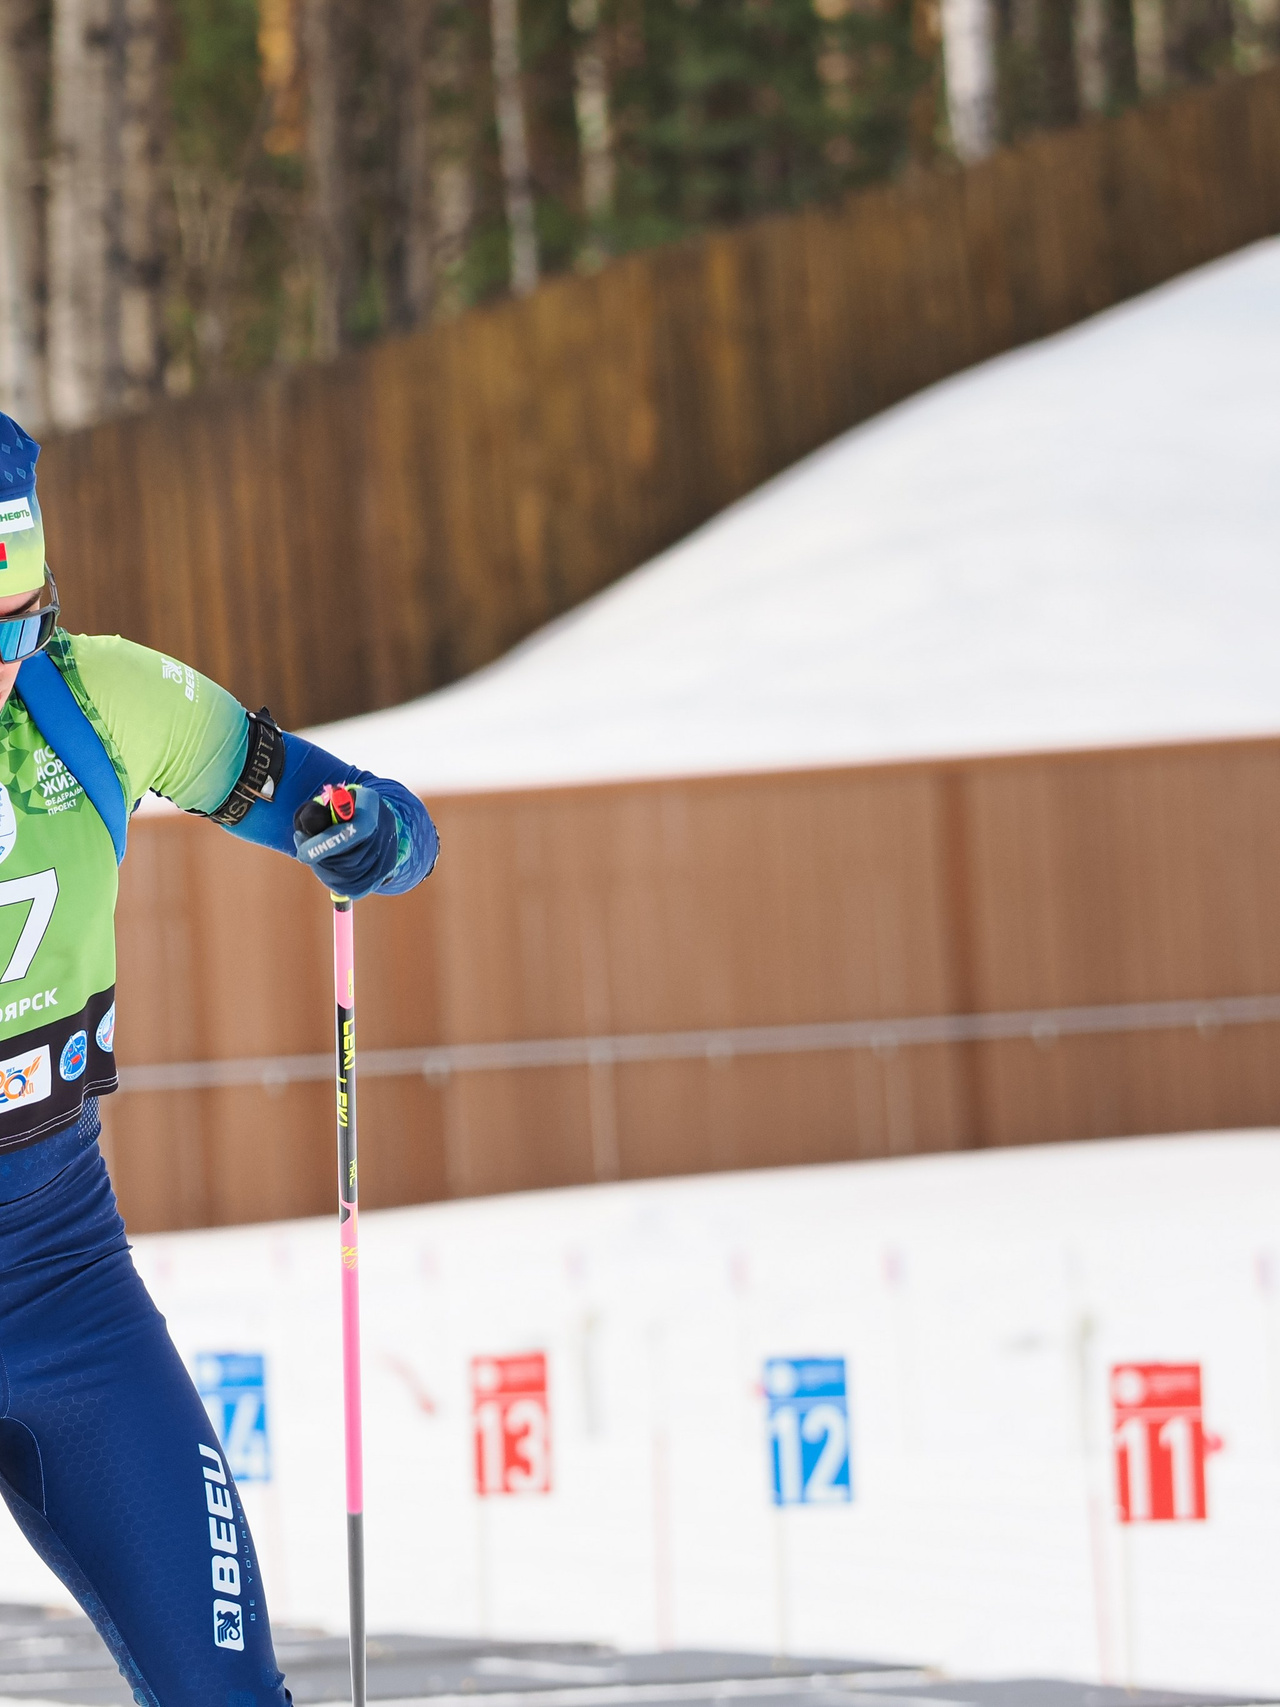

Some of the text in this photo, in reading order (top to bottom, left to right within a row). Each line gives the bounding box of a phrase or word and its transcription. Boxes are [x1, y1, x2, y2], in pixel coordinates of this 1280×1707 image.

[184, 667, 195, 702] BEE
[37, 758, 68, 782] НОР
[39, 771, 78, 798] ЖИЗ
[45, 786, 84, 806] ФЕДЕРАЛЬ
[47, 798, 77, 816] ПРОЕКТ
[476, 1399, 546, 1494] 13
[770, 1403, 848, 1502] 12
[1116, 1415, 1194, 1519] 11
[198, 1443, 242, 1596] BEEU
